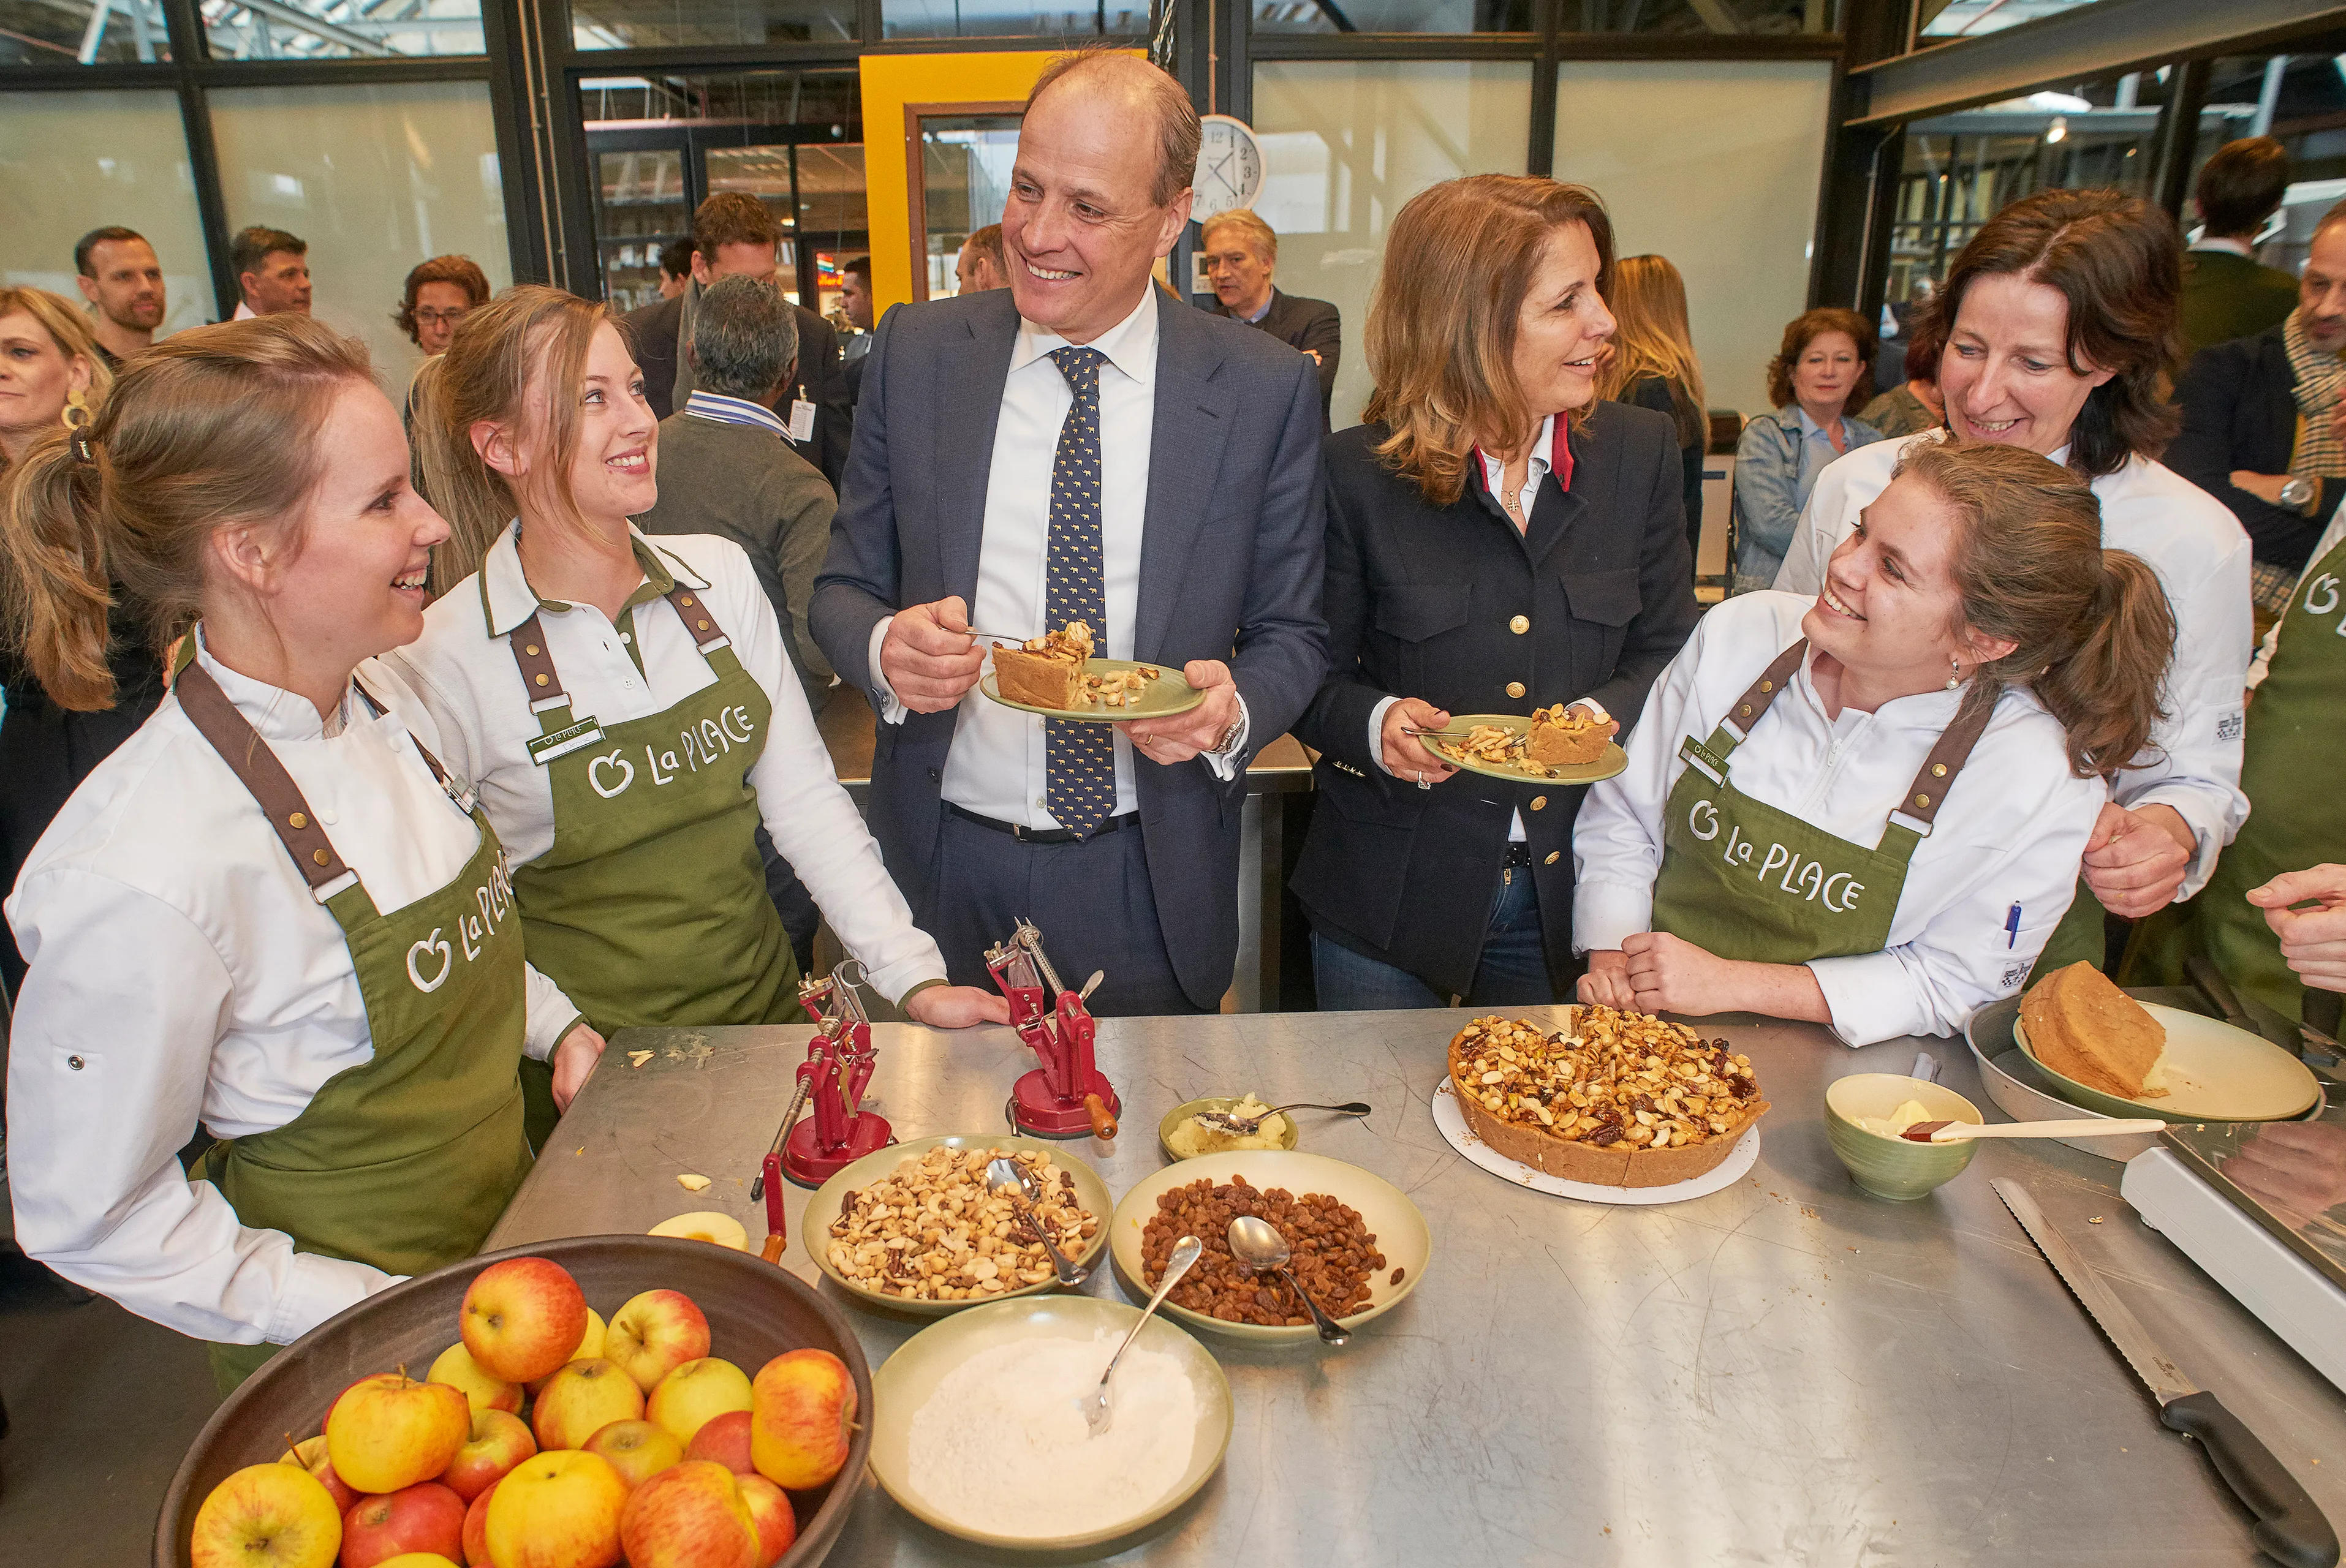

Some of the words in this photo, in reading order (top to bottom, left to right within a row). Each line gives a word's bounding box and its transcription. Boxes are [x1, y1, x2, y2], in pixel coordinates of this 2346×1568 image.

[1211, 131, 1223, 143] 12
[1240, 147, 1247, 160] 2
[1244, 166, 1251, 179] 3
[1209, 198, 1217, 211] 6
[1226, 196, 1233, 208] 5
[562, 726, 582, 739] PLACE
[645, 744, 680, 786] La
[681, 705, 755, 772] PLACE
[1705, 752, 1719, 767] PLACE
[1724, 826, 1755, 867] La
[1757, 842, 1865, 913] PLACE
[459, 914, 483, 962] La
[476, 849, 513, 936] PLAC
